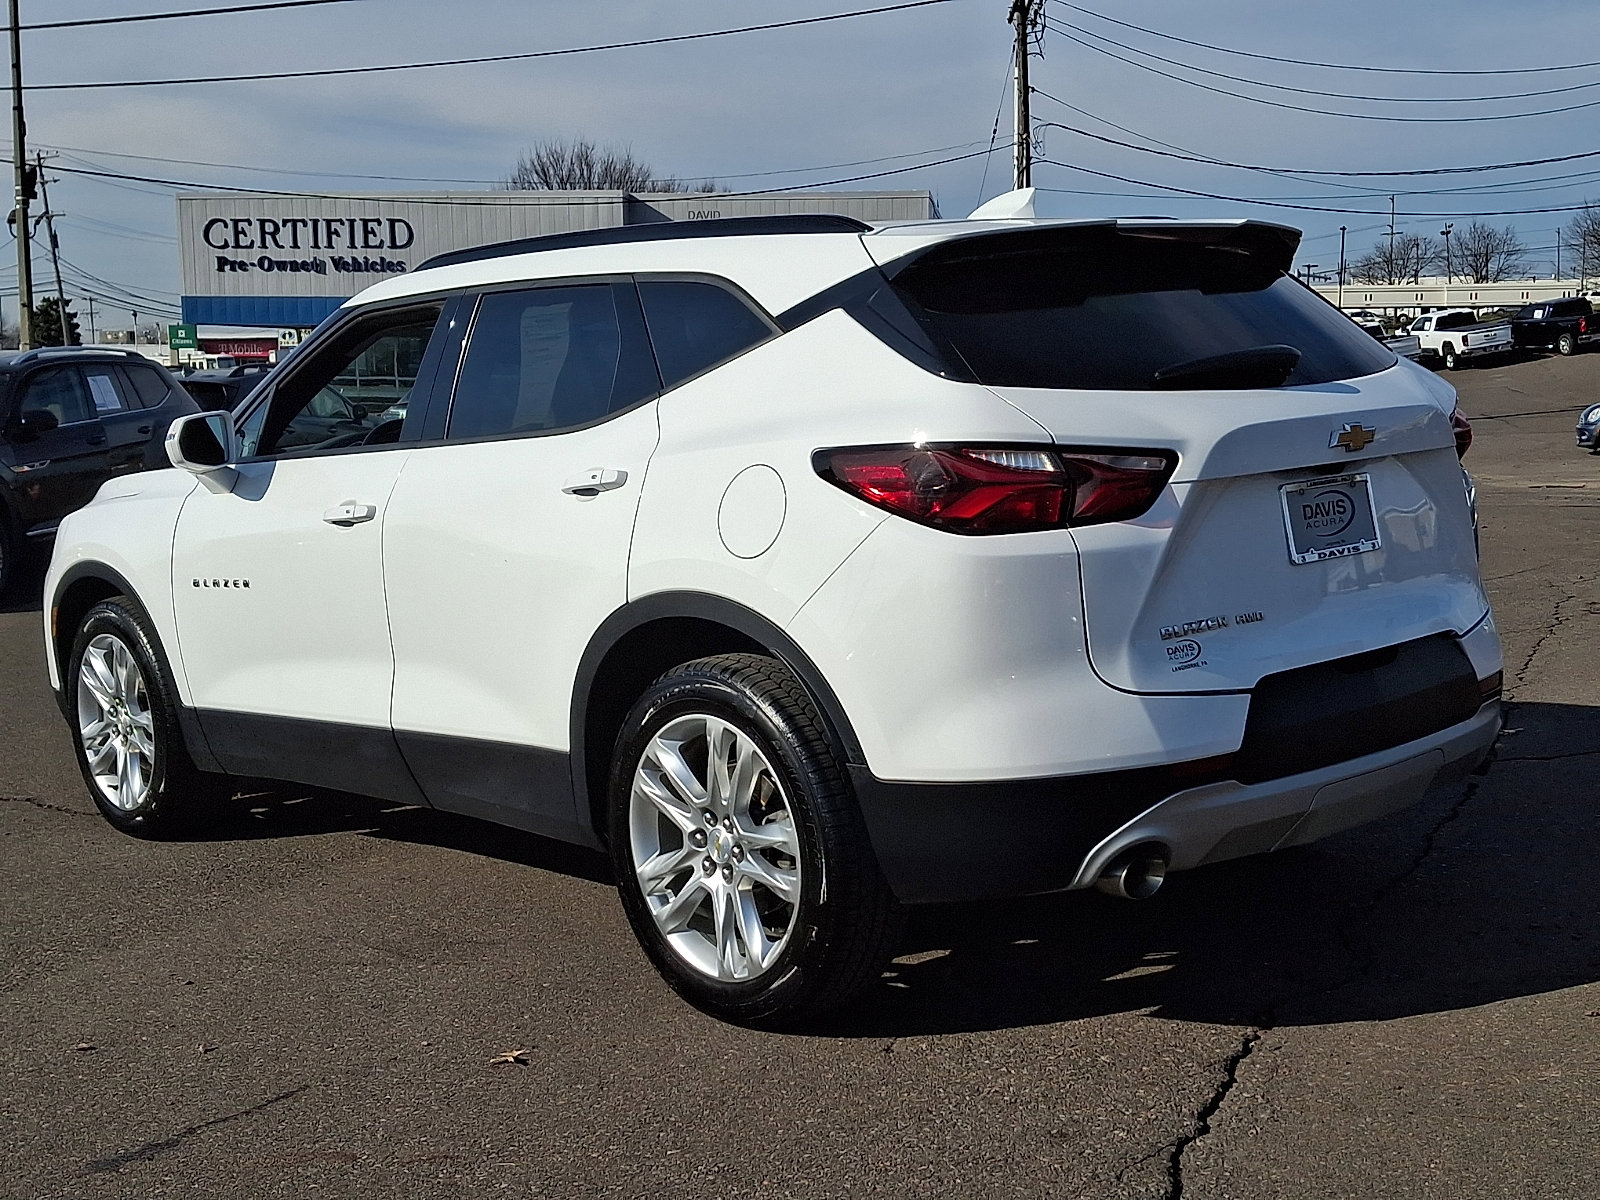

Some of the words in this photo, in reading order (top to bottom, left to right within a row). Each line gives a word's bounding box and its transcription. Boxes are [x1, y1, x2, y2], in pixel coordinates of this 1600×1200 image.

[687, 210, 721, 220] DAVID
[202, 217, 415, 250] CERTIFIED
[215, 255, 328, 275] Pre-Owned
[329, 255, 407, 273] Vehicles
[1302, 498, 1347, 521] DAVIS
[1305, 517, 1346, 530] ACURA
[1317, 545, 1361, 560] DAVIS
[192, 578, 251, 589] BLAZER
[1159, 615, 1229, 641] BLAZER
[1166, 643, 1196, 656] DAVIS
[1168, 652, 1195, 661] ACURA
